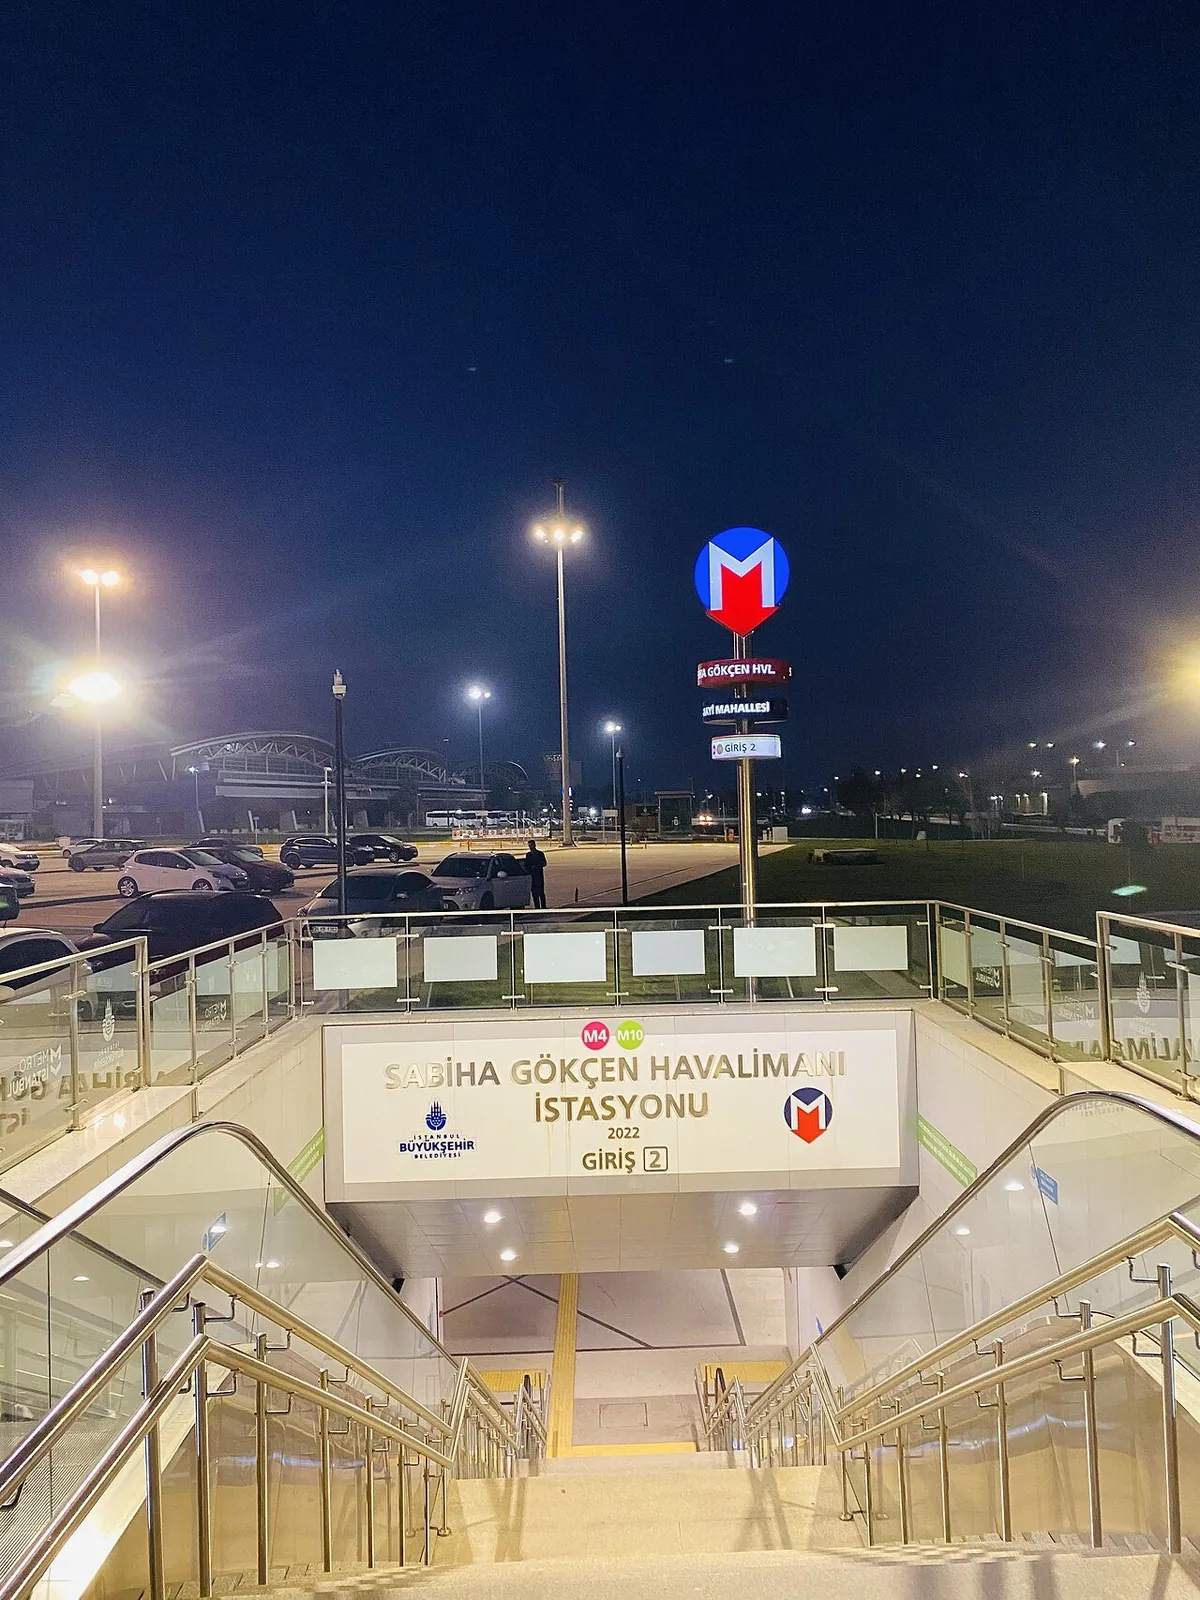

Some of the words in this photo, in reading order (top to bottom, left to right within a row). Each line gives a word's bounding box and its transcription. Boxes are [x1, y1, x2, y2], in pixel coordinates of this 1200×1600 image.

[709, 537, 775, 610] M
[707, 663, 750, 678] GÖKÇEN
[715, 701, 770, 714] MAHALLESİ
[724, 742, 747, 753] GİRİŞ
[750, 743, 756, 752] 2
[583, 1029, 608, 1043] M4
[617, 1029, 644, 1041] M10
[384, 1056, 501, 1090] SABİHA
[511, 1053, 638, 1090] GÖKÇEN
[650, 1048, 846, 1081] HAVALİMANI
[535, 1091, 709, 1123] İSTASYONU
[791, 1093, 827, 1130] M
[607, 1126, 640, 1139] 2022
[399, 1137, 475, 1154] BÜYÜKŞEHİR
[582, 1147, 636, 1174] GİRİŞ
[649, 1150, 661, 1168] 2
